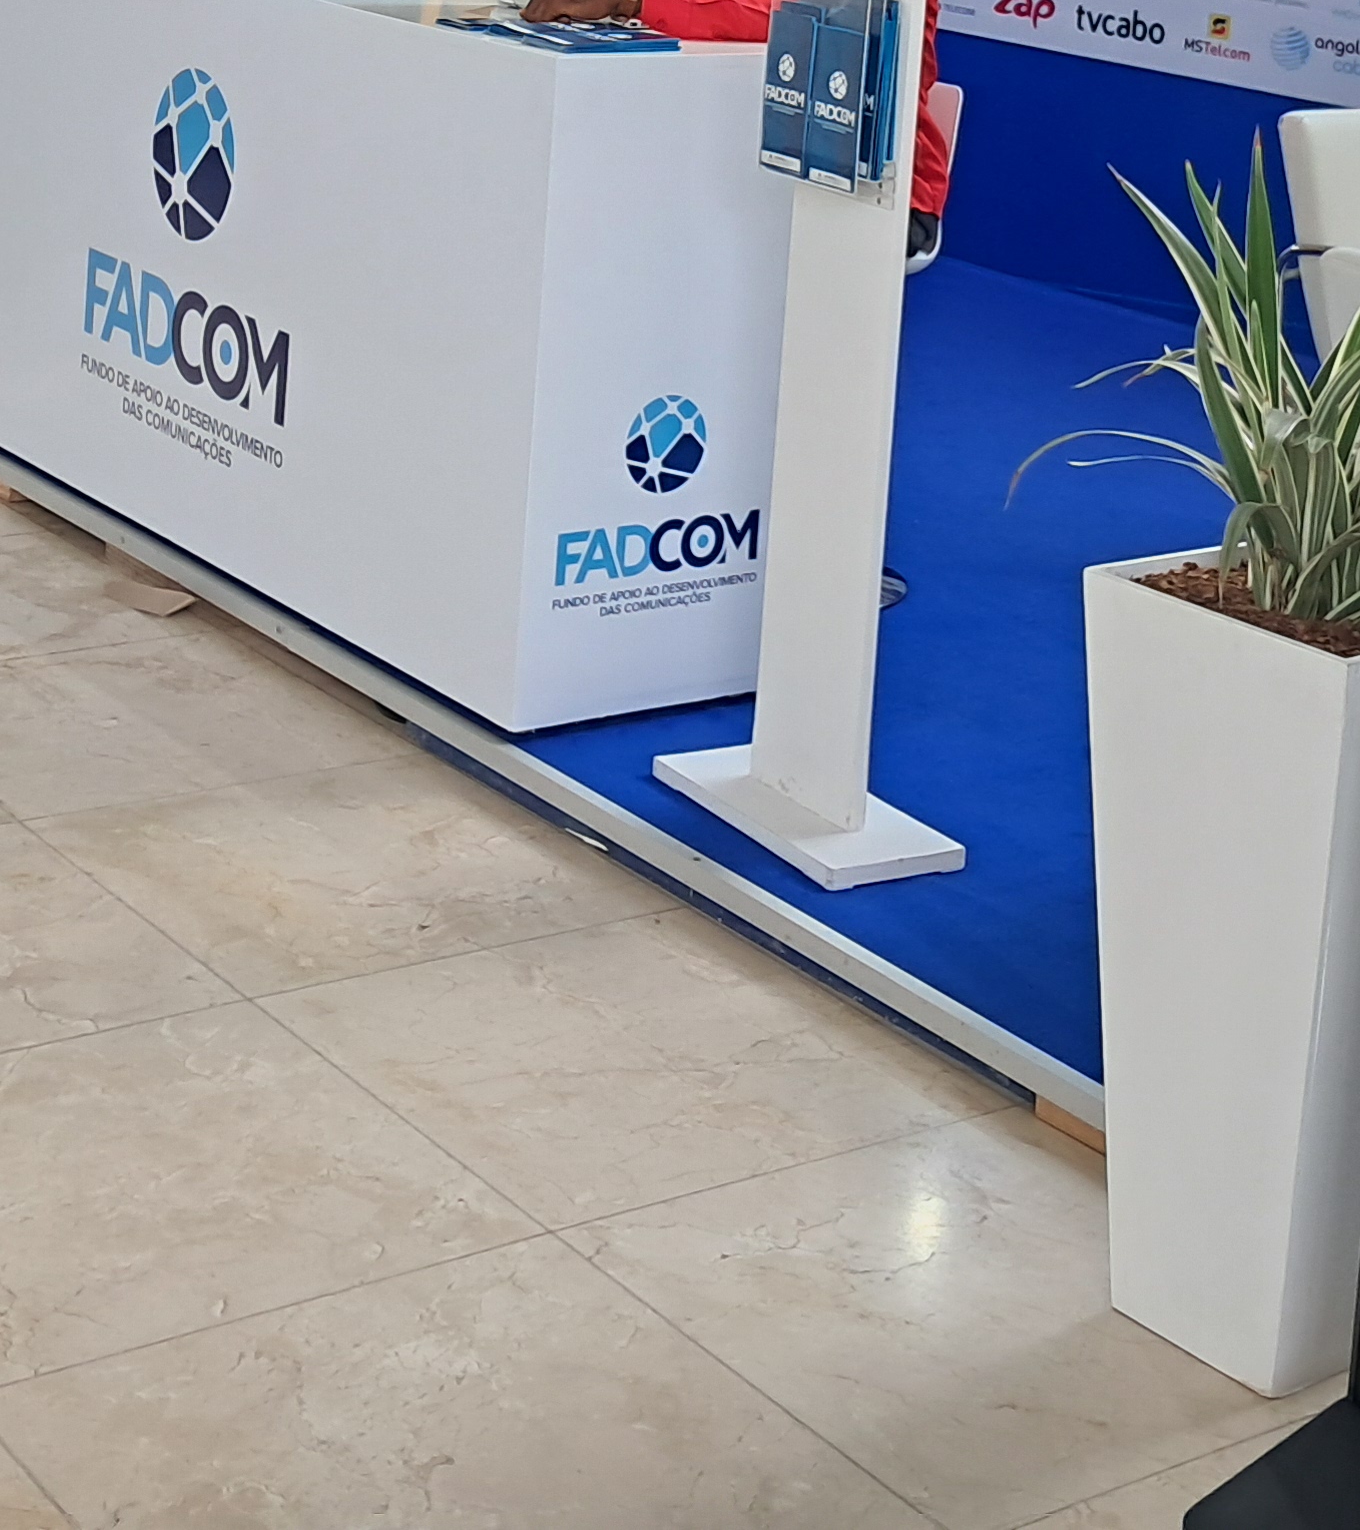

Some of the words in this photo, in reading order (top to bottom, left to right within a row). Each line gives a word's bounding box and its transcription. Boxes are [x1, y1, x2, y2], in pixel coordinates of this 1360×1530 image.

[1076, 5, 1166, 45] tvcabo
[1183, 38, 1250, 62] MSTelcom
[765, 83, 805, 108] FADCOM
[814, 100, 856, 127] FADCOM
[83, 247, 290, 427] FADCOM
[81, 353, 115, 383] FUNDO
[117, 374, 130, 392] DE
[132, 378, 163, 408] APOIO
[165, 396, 180, 416] AO
[182, 403, 283, 468] DESENVOLVIMENTO
[122, 397, 143, 421] DAS
[145, 410, 233, 468] COMUNICAÇÕES
[555, 509, 760, 586] FADCOM
[552, 595, 590, 610] FUNDO
[592, 593, 607, 604] DE
[609, 587, 642, 602] APOIO
[644, 585, 660, 596] AO
[662, 572, 757, 595] DESENVOLVIMENTO
[599, 605, 621, 617] DAS
[624, 591, 711, 613] COMUNICAÇÕES
